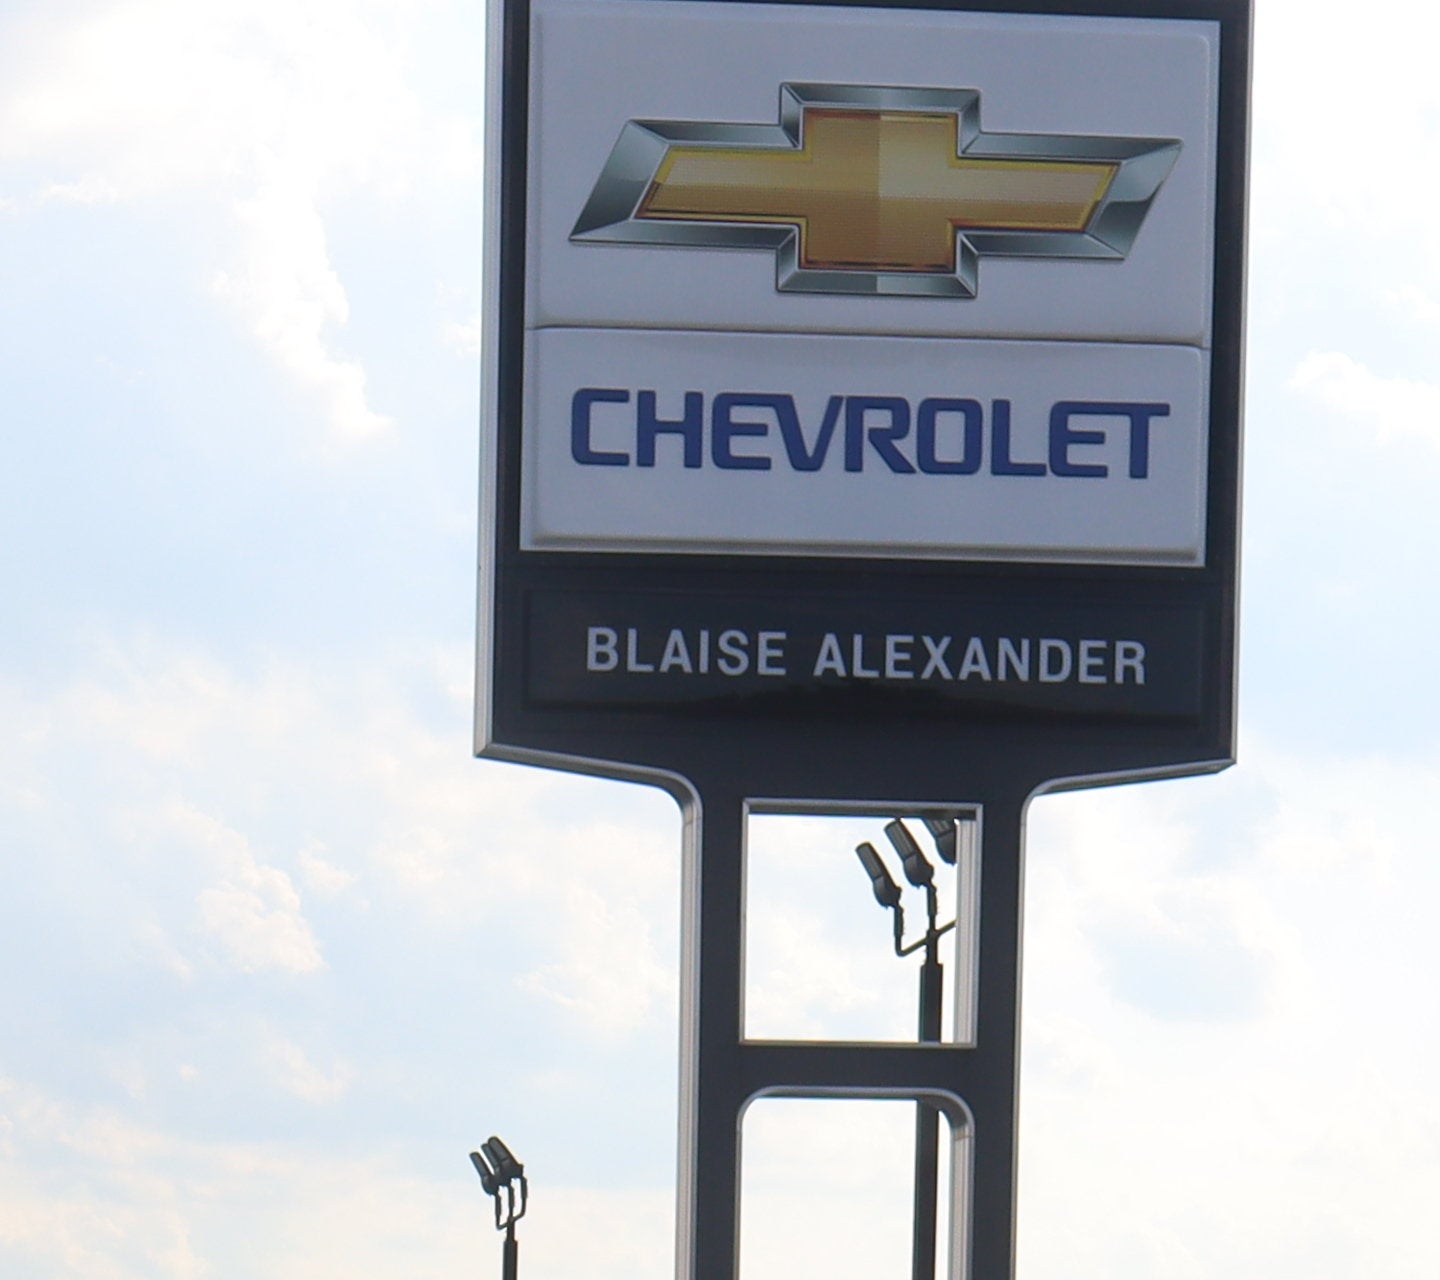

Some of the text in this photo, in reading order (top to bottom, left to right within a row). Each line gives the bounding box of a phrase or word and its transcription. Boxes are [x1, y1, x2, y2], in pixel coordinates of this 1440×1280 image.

[571, 388, 1170, 479] CHEVROLET
[586, 626, 1148, 686] BLAISE ALEXANDER
